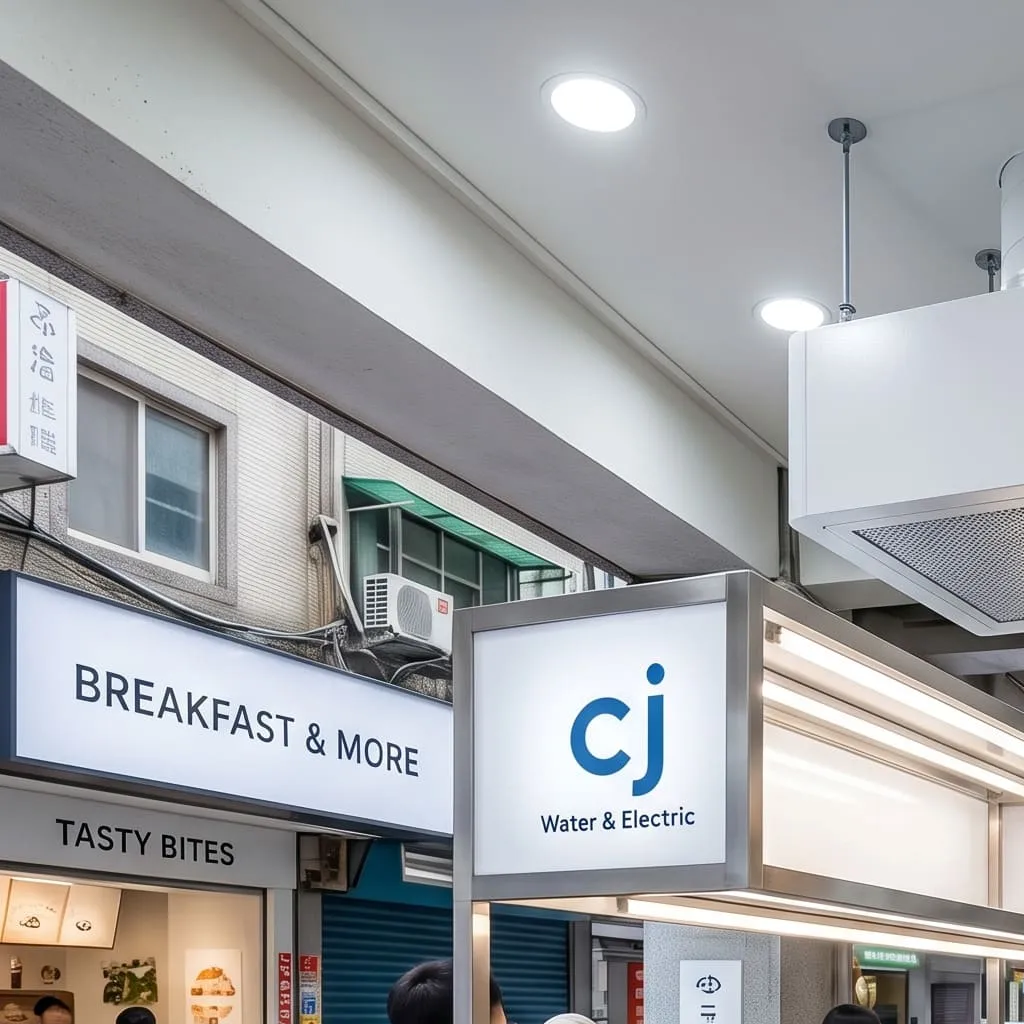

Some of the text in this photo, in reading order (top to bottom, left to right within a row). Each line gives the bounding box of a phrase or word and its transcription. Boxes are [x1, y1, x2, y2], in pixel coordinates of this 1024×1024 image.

[75, 663, 419, 777] BREAKFAST & MORE
[570, 662, 666, 797] cj
[55, 818, 235, 866] TASTY BITES
[540, 806, 696, 833] Water & Electric
